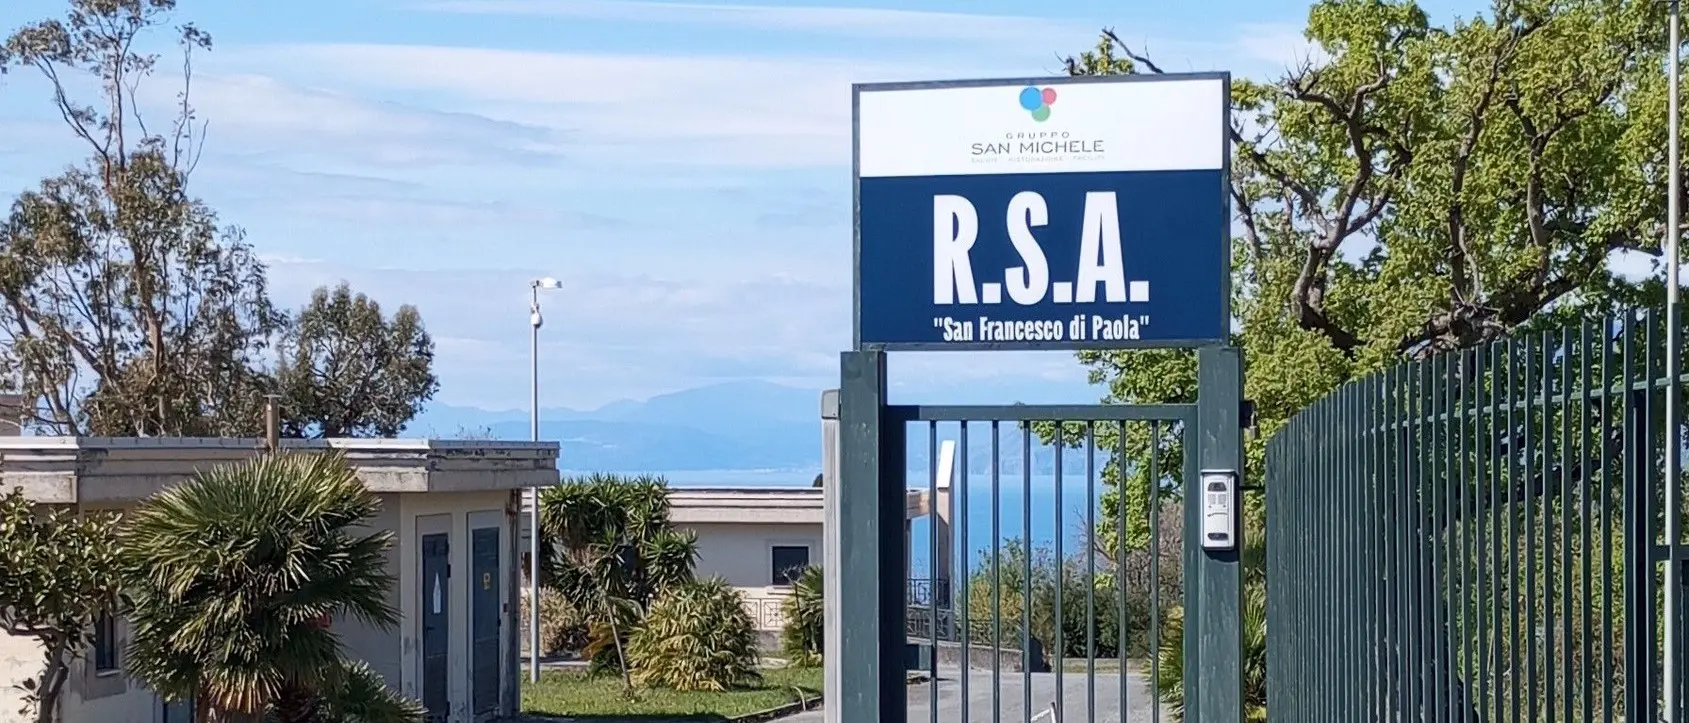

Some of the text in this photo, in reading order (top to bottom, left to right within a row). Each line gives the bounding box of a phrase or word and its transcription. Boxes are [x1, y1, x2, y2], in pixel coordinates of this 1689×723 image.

[1006, 131, 1070, 139] GRUPPO
[971, 140, 1105, 155] SAN MICHELE
[934, 191, 1149, 305] R.S.A.
[934, 314, 1149, 341] "San Francesco di Paola"
